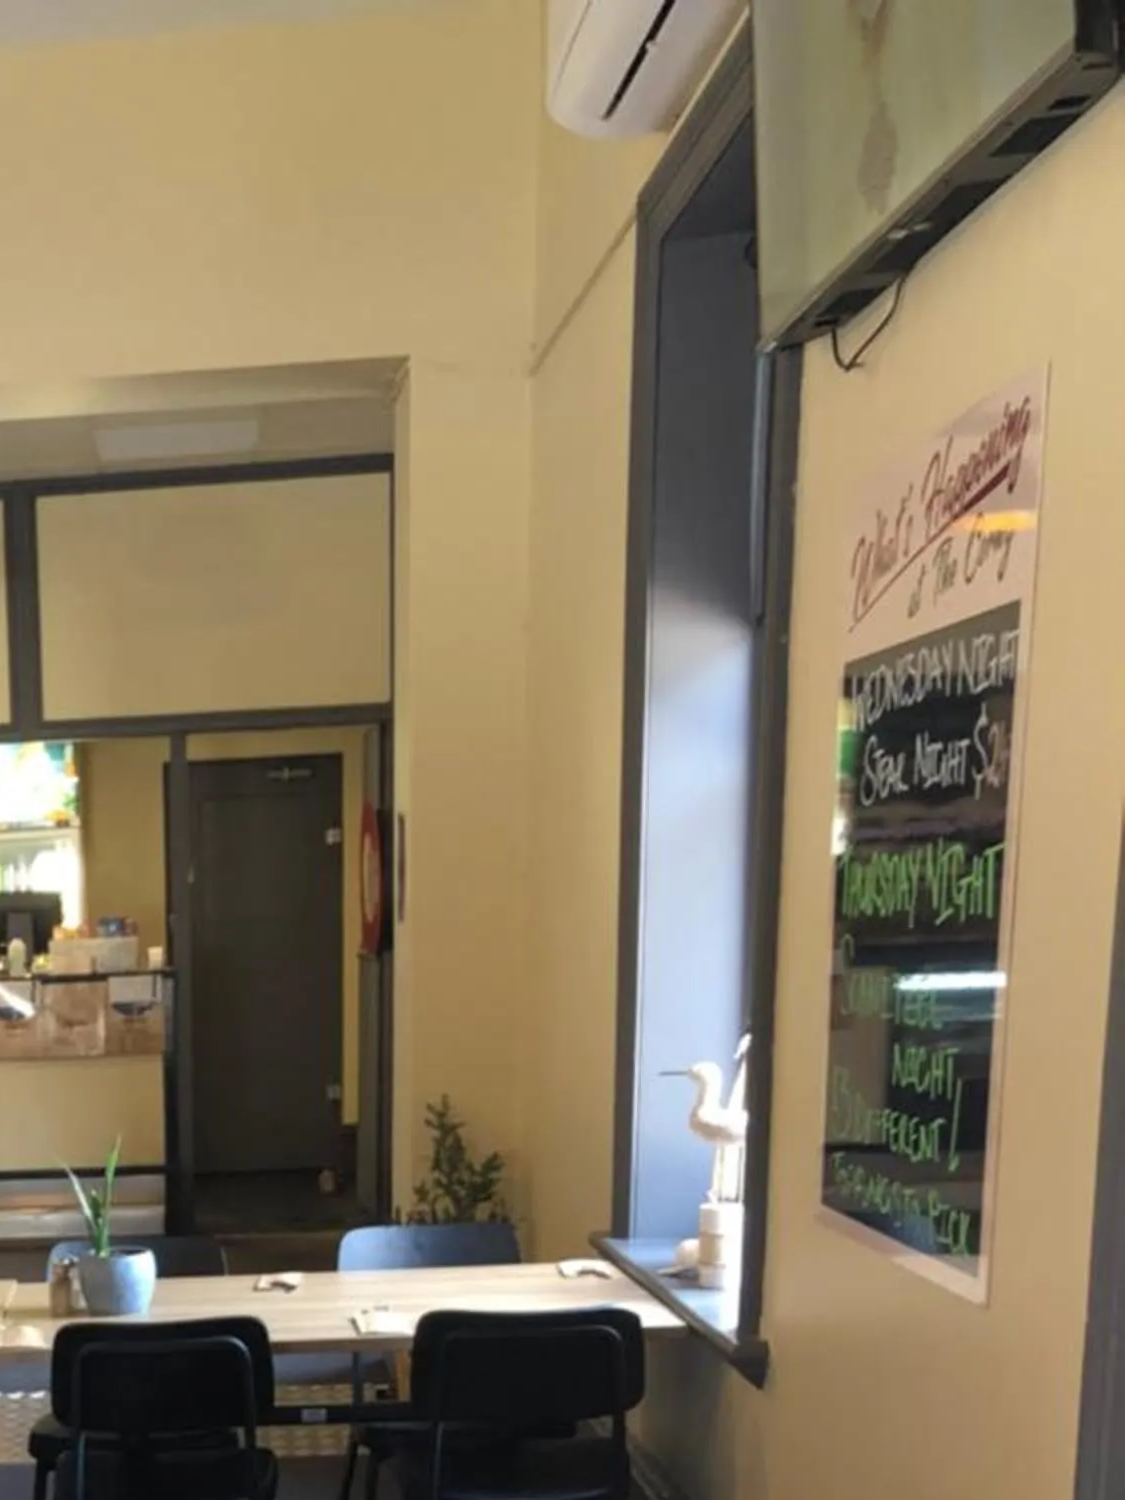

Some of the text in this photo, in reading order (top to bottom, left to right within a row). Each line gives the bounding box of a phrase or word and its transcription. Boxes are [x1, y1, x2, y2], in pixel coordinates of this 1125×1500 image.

[849, 628, 1020, 732] WEDNESDAY NIGHT
[913, 730, 972, 789] NIGHT
[839, 837, 1005, 928] THURSDAY NIGHT
